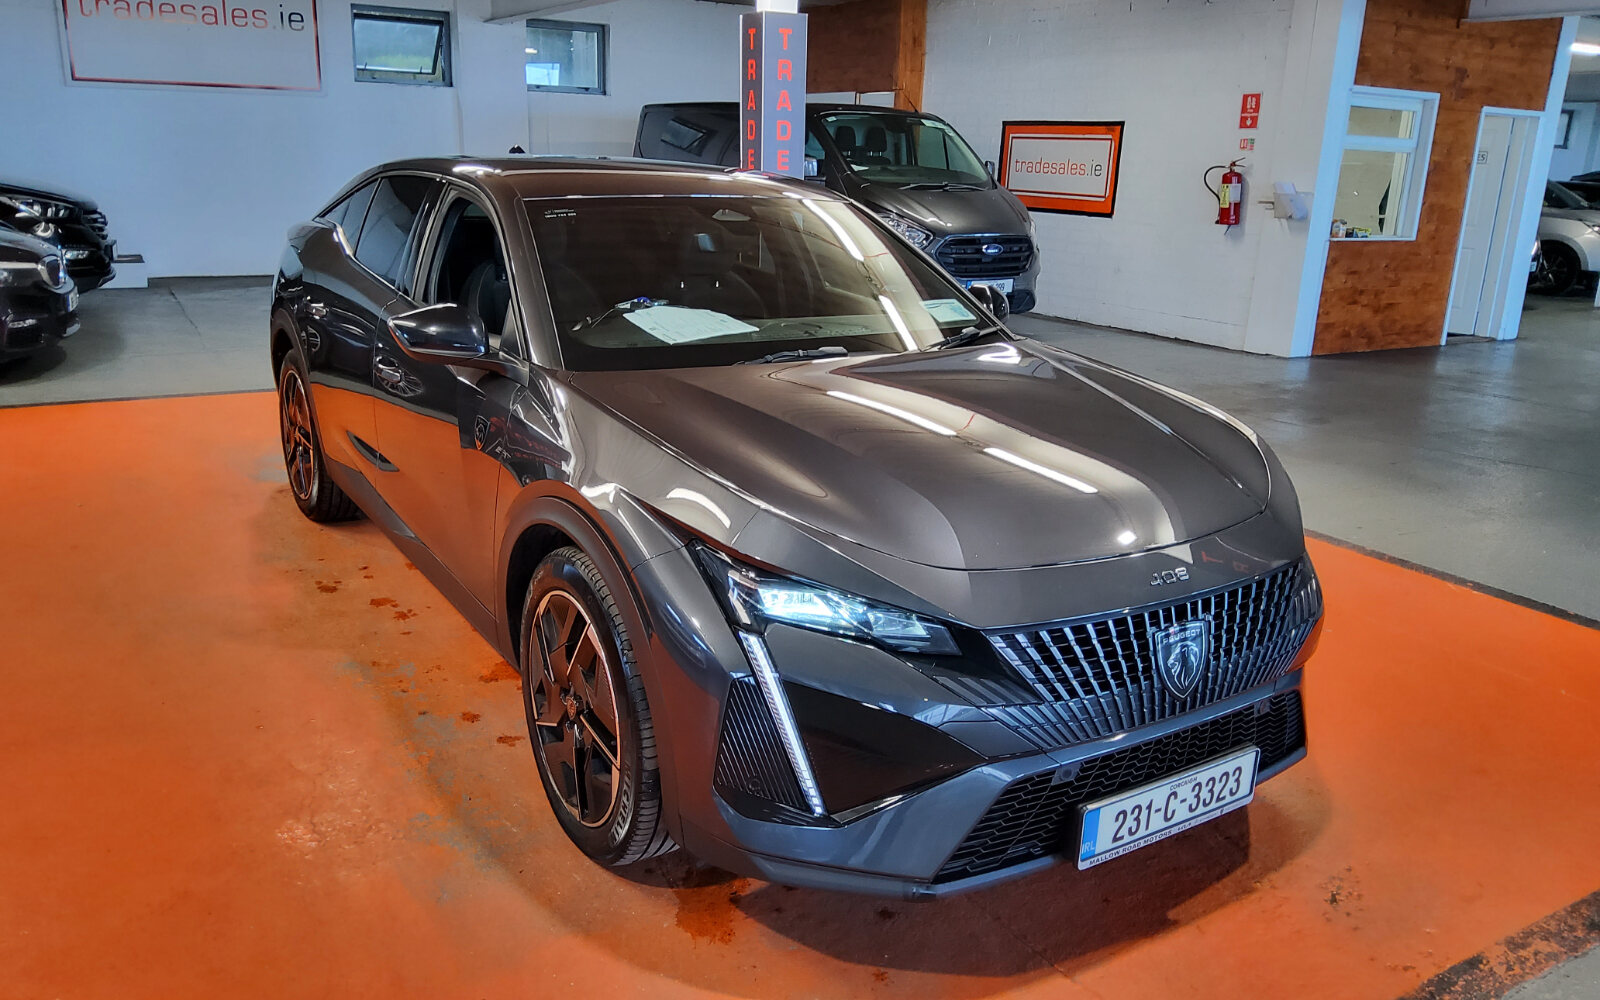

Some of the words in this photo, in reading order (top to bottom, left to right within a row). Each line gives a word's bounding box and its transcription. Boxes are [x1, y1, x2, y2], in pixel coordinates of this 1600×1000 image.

[79, 0, 305, 32] tradesales.ie
[747, 28, 757, 170] TRADE
[776, 28, 793, 171] TRADE
[1015, 156, 1103, 177] tradesales.ie
[1150, 567, 1190, 586] 408
[1162, 628, 1201, 644] PEUGEOT
[1111, 766, 1243, 844] 231-C-3323
[1081, 841, 1096, 853] IRL
[1089, 849, 1122, 866] MALLOW
[1122, 840, 1142, 853] ROAD
[1143, 829, 1172, 845] MOTORS
